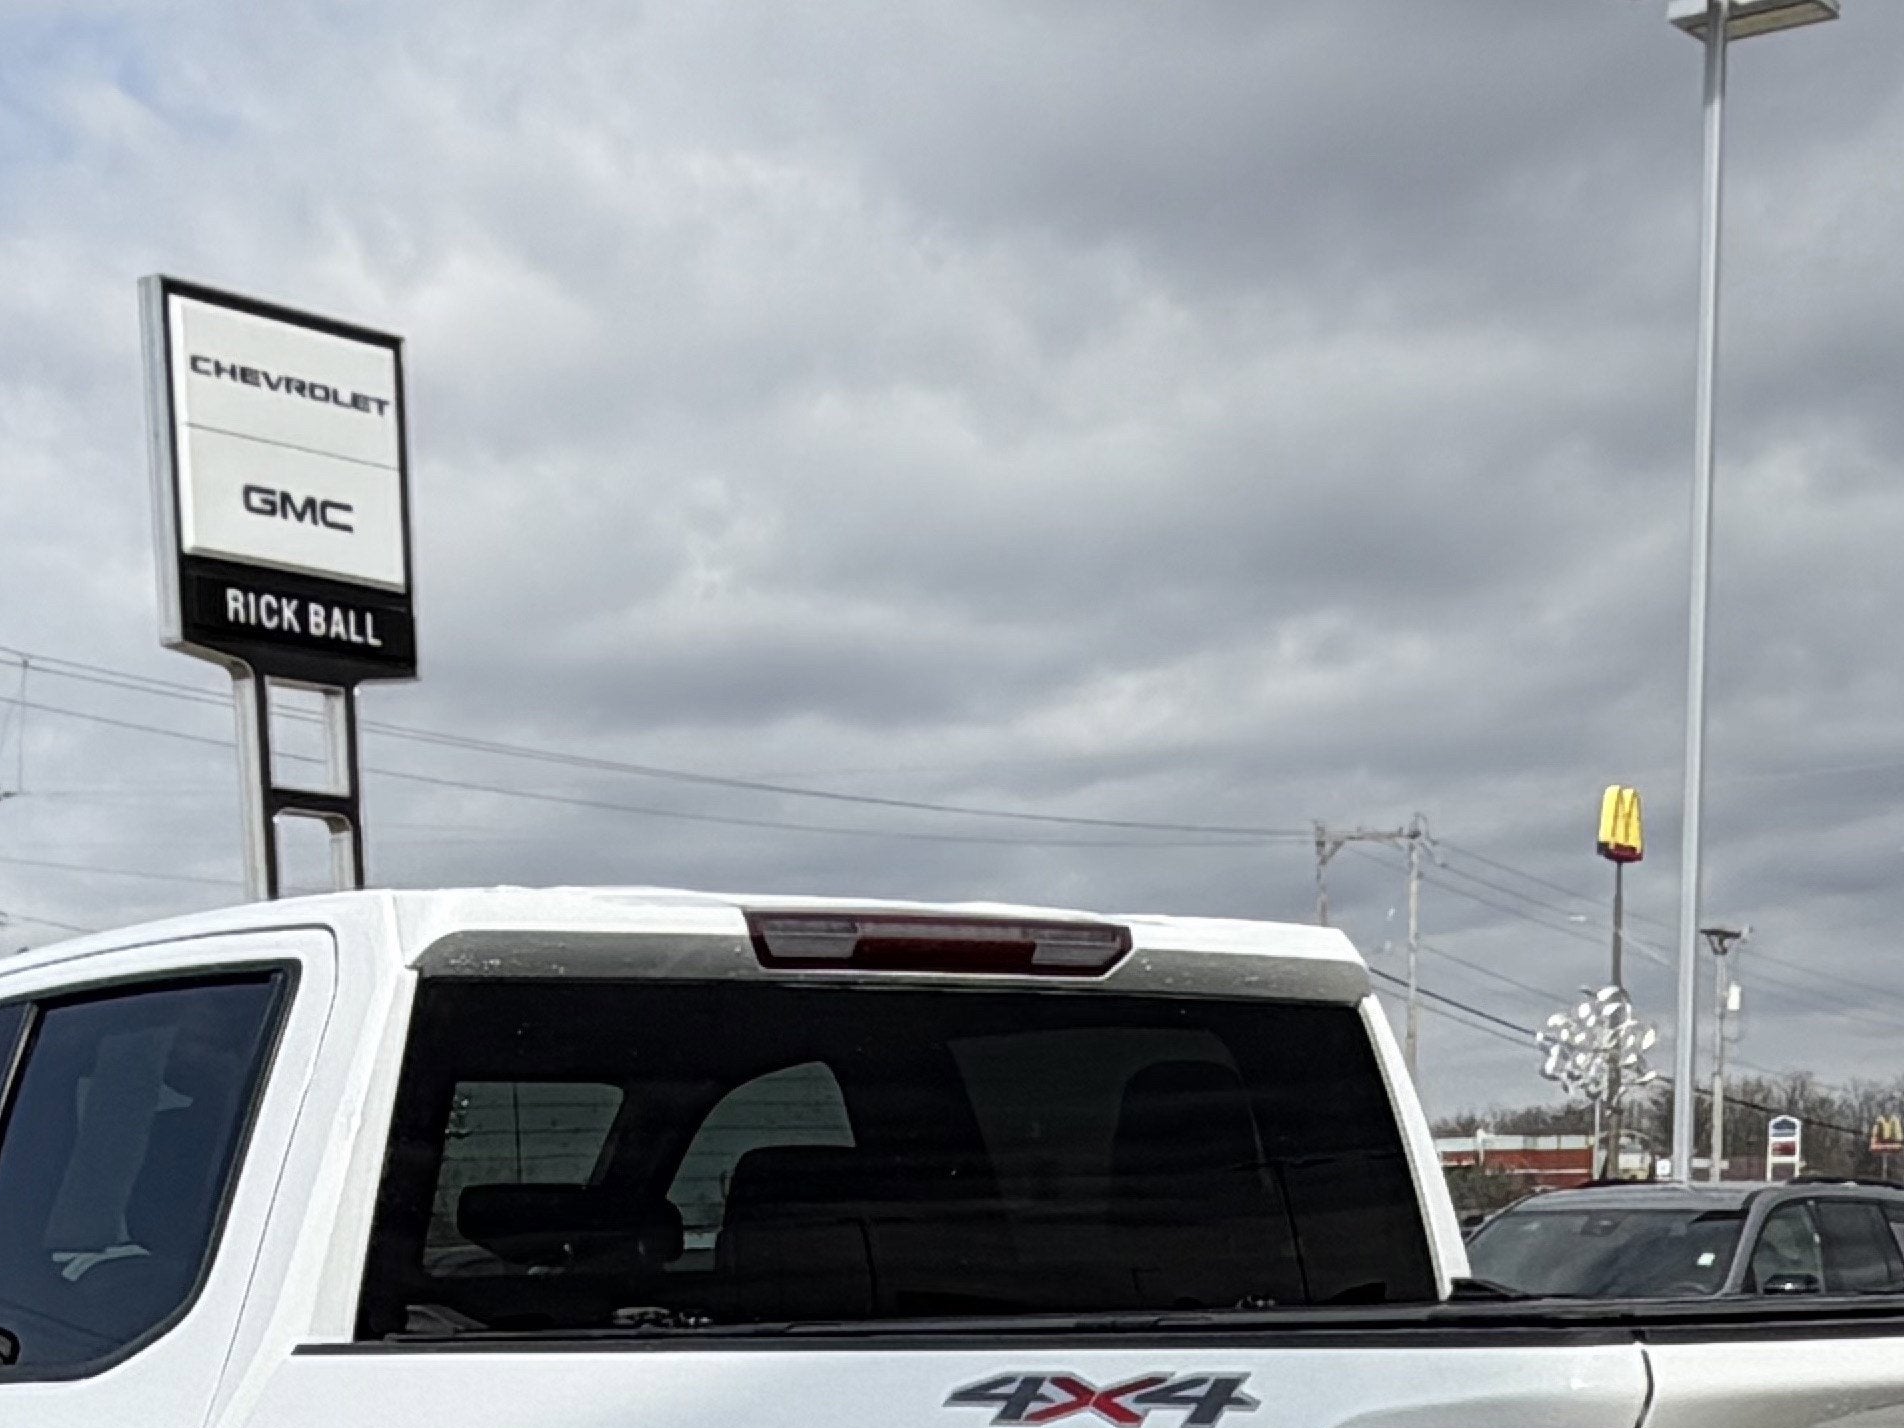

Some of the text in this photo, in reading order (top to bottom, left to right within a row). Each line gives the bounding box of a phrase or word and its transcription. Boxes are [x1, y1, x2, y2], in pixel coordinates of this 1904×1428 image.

[190, 354, 390, 417] CHEVROLET
[242, 484, 354, 533] GMC
[226, 587, 383, 647] RICK BALL
